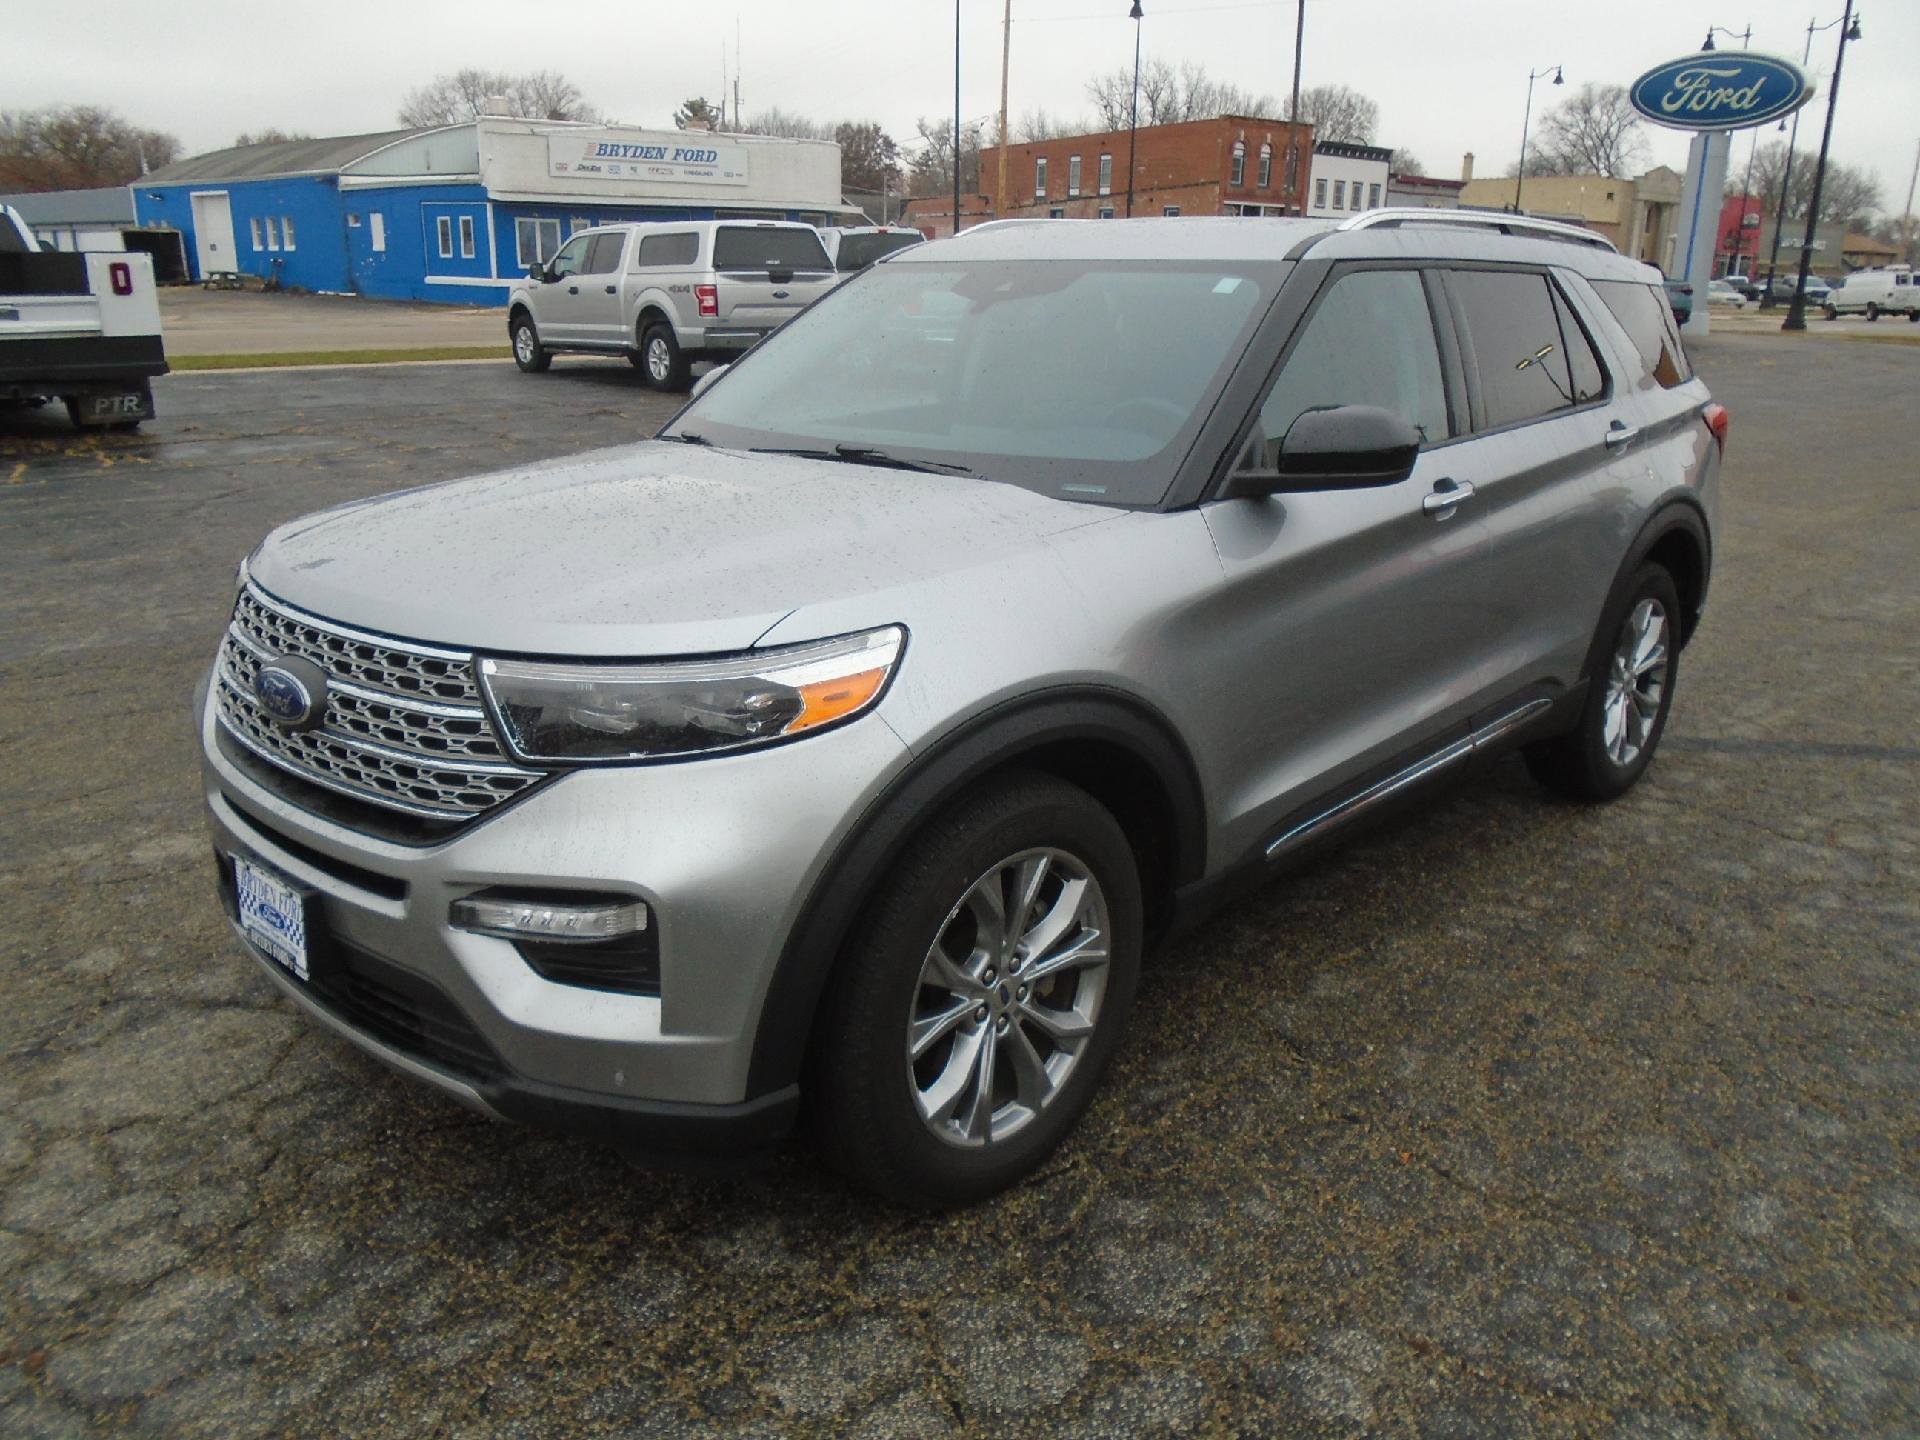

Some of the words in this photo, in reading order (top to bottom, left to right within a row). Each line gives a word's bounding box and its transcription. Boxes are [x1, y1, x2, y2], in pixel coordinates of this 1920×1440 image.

[1661, 67, 1767, 113] Ford
[596, 143, 668, 160] BRYDEN
[672, 148, 718, 163] FORD
